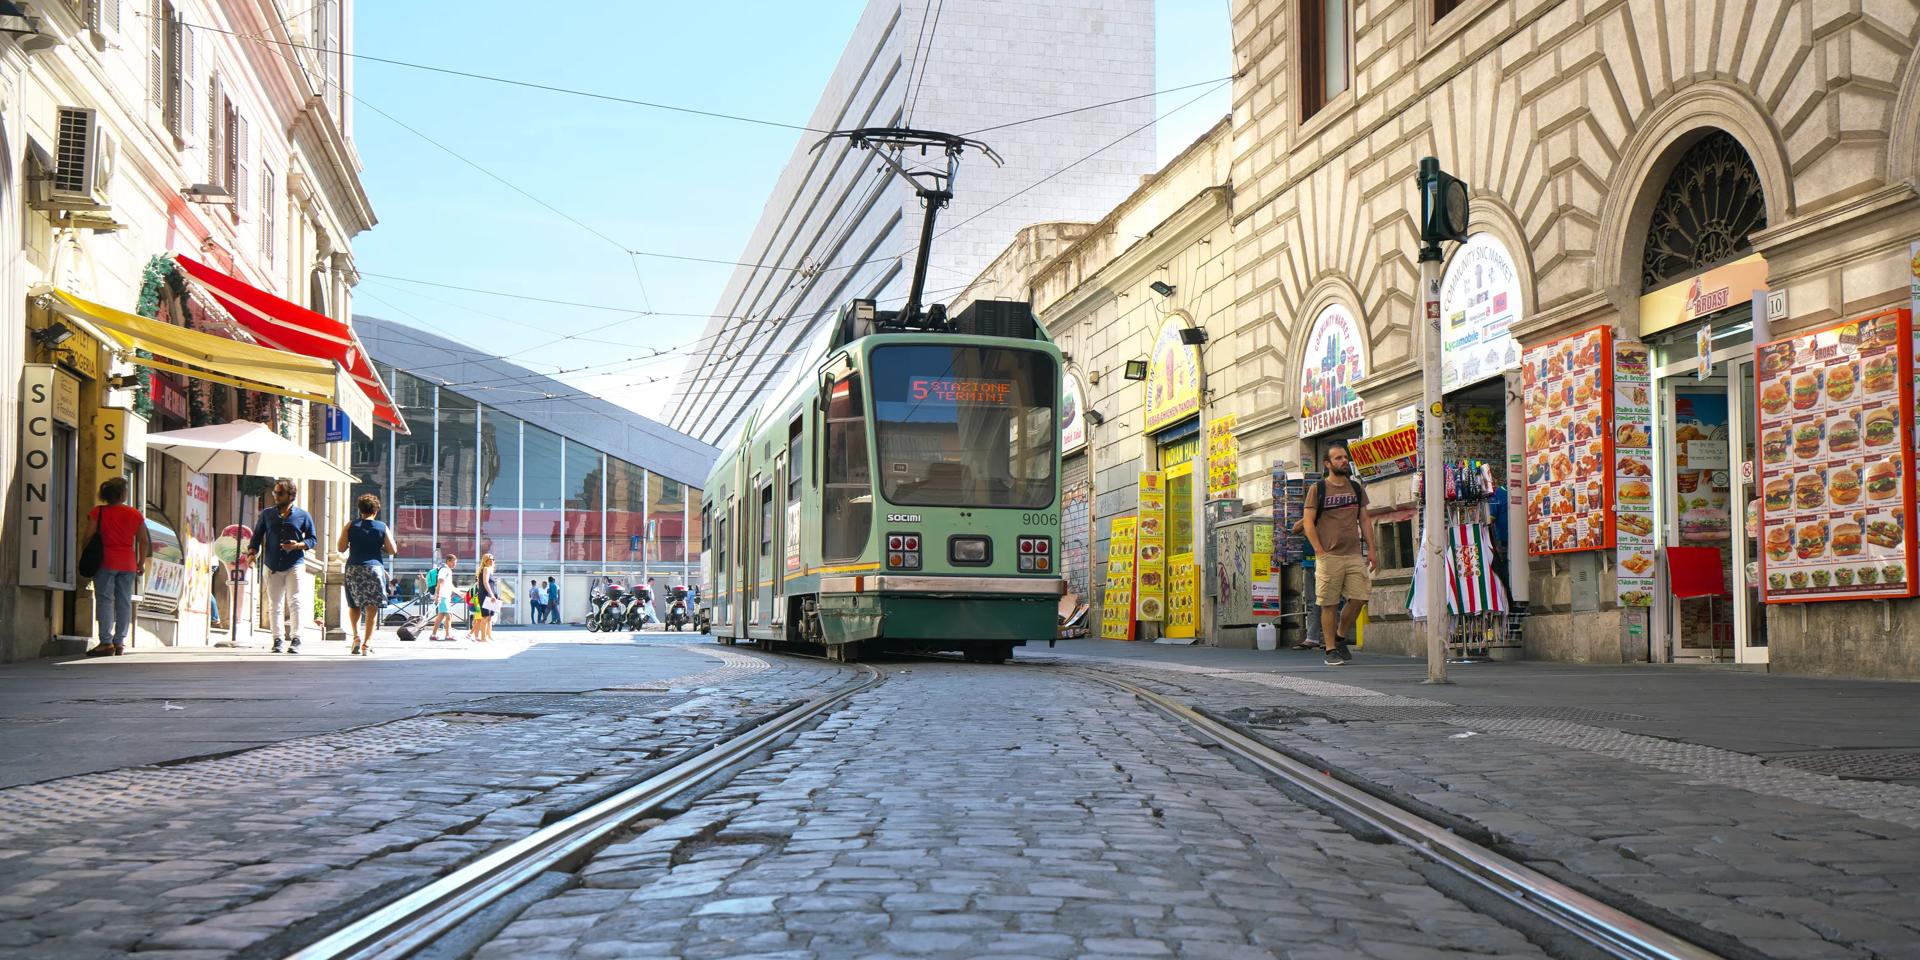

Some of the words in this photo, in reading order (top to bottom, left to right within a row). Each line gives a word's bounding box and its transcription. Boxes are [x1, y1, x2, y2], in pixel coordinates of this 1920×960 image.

[1695, 289, 1729, 314] BROAST
[1770, 298, 1782, 314] 10
[1444, 328, 1479, 352] Lycamobile
[912, 380, 929, 400] 5
[930, 381, 1011, 393] STAZIONE
[936, 391, 1005, 402] TERMINI
[1303, 401, 1364, 434] SUPERMARKET
[1349, 443, 1377, 468] MONEY
[1372, 428, 1417, 462] TRANSFER
[25, 382, 49, 570] SCONTI
[1325, 494, 1358, 505] ELEMEN
[887, 513, 921, 523] SOCIMI
[1022, 512, 1058, 526] 9006
